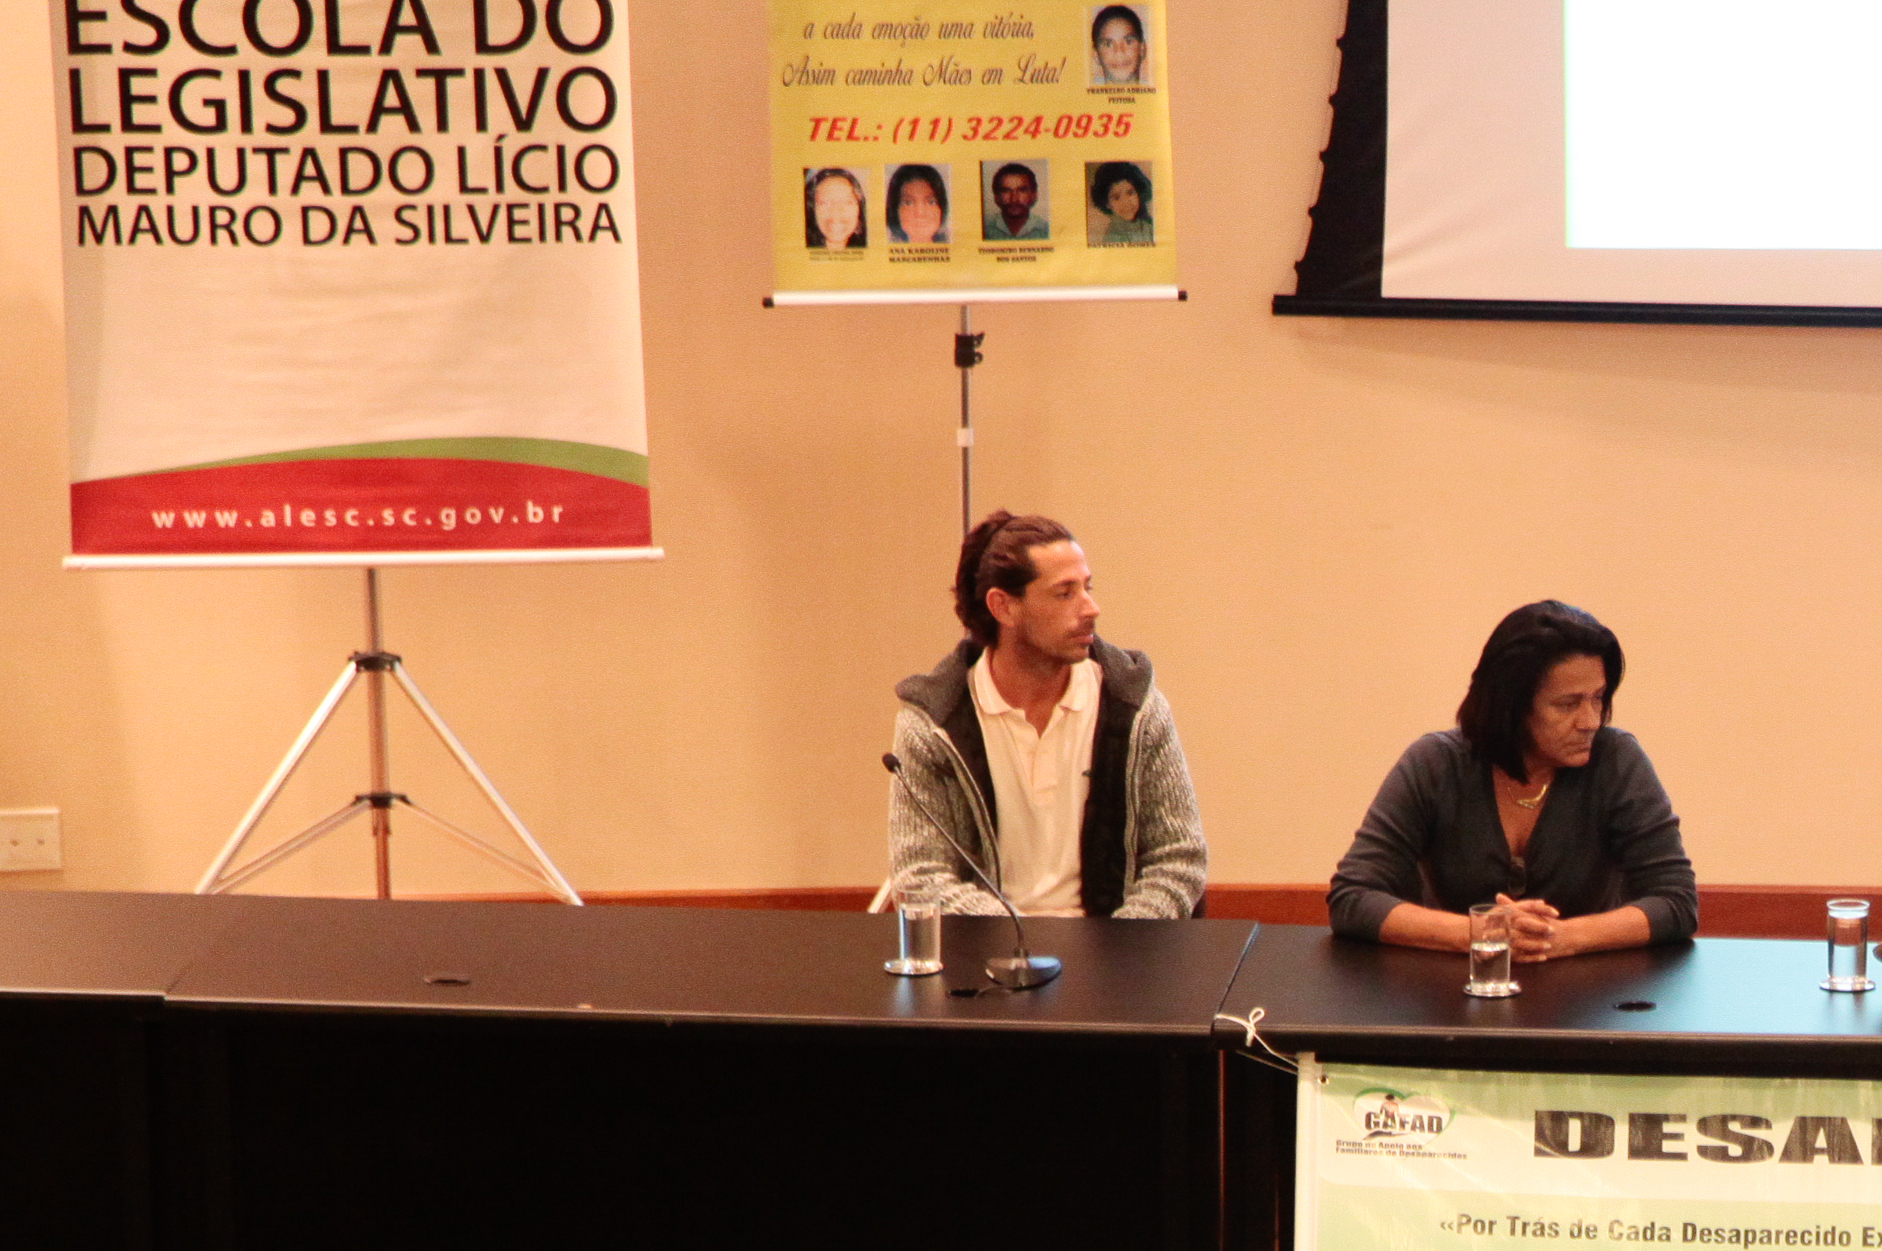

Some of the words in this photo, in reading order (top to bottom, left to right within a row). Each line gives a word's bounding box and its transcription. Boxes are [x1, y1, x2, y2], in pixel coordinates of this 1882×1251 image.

[66, 0, 440, 56] ESCOLA
[474, 0, 614, 55] DO
[804, 22, 815, 39] a
[823, 12, 863, 39] cada
[872, 16, 930, 47] emoção
[938, 22, 974, 39] uma
[782, 55, 836, 87] Assim
[846, 60, 913, 86] caminha
[923, 55, 972, 87] Mães
[982, 67, 1003, 85] em
[1015, 54, 1067, 84] Luta!
[68, 66, 618, 135] LEGISLATIVO
[809, 116, 883, 142] TEL.:
[892, 117, 953, 144] (11)
[962, 113, 1134, 141] 3224-0935
[73, 144, 435, 197] DEPUTADO
[457, 134, 620, 194] LÍCIO
[77, 205, 282, 246] MAURO
[302, 205, 376, 246] DA
[395, 201, 622, 244] SILVEIRA
[152, 502, 563, 530] www.alesc.sc.gov.br
[1506, 1215, 1560, 1239] Trás
[1569, 1218, 1598, 1240] de
[1607, 1219, 1672, 1243] Cada
[1682, 1222, 1852, 1250] Desaparecido
